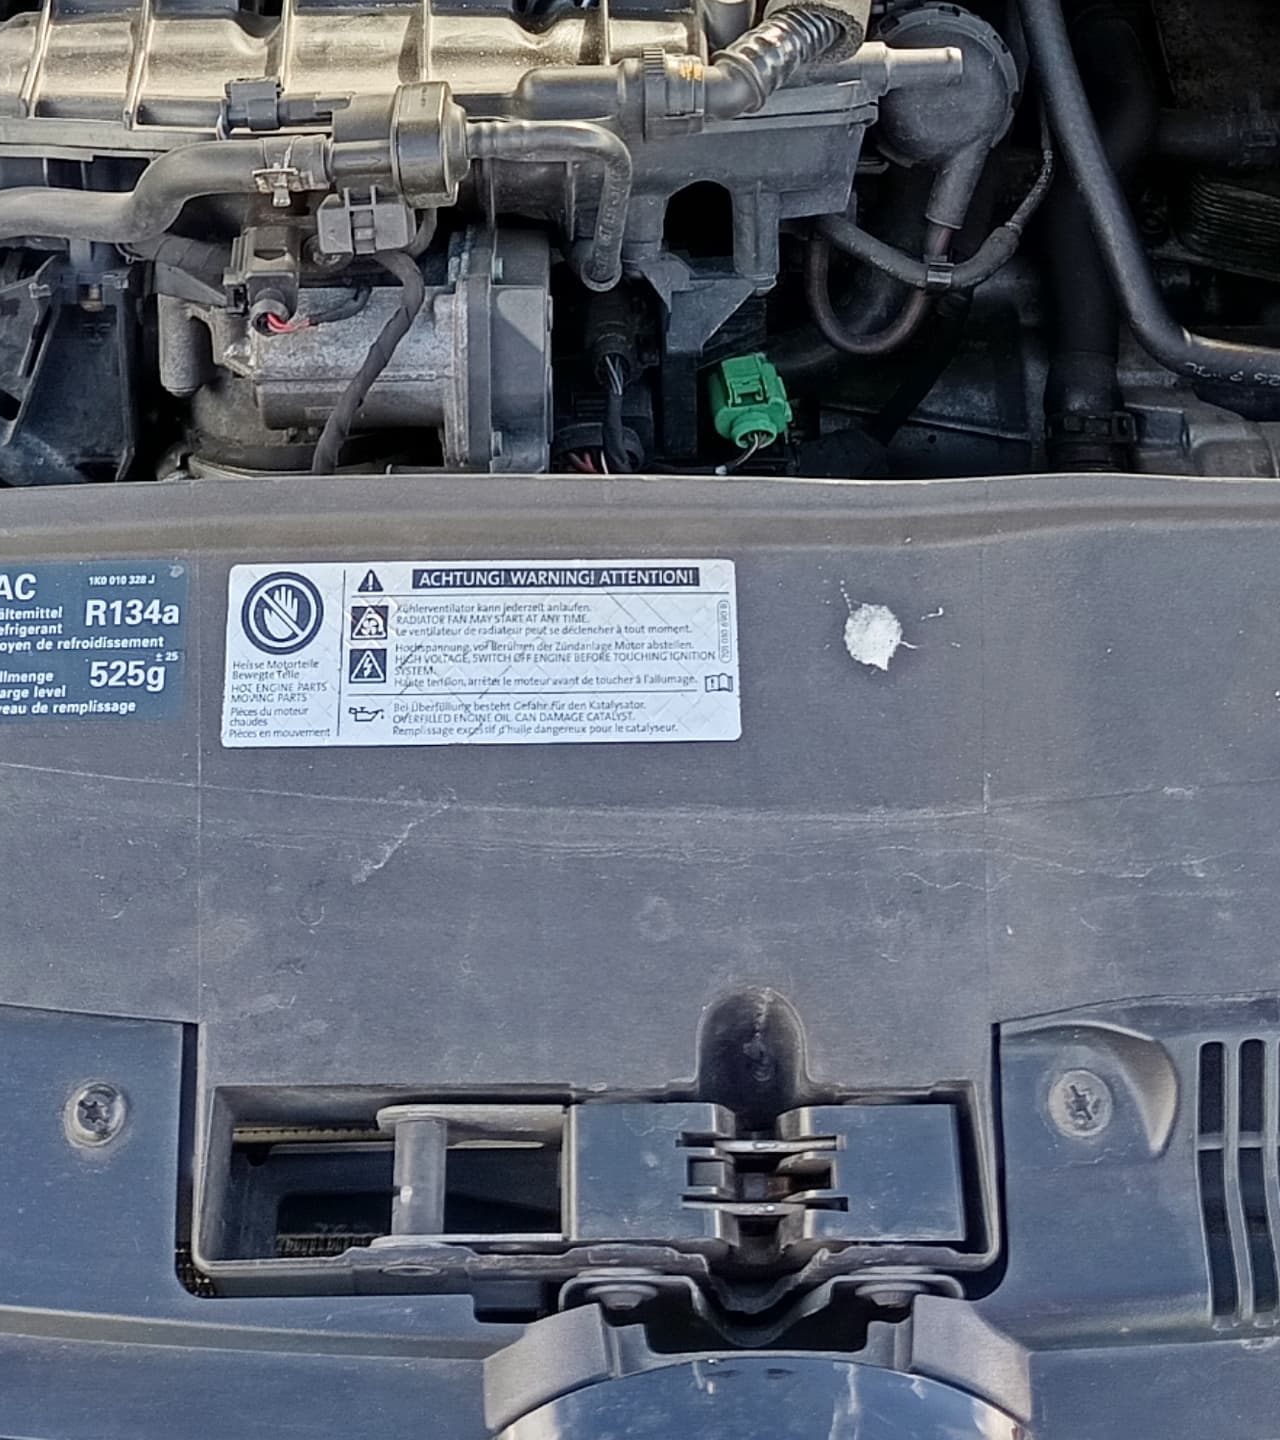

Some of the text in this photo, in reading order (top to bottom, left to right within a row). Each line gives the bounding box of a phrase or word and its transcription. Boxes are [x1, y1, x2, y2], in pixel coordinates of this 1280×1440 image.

[419, 570, 694, 586] ACHTUNG! WARNING! ATTENTION!
[85, 599, 180, 627] R134a
[477, 603, 501, 612] kann
[503, 603, 544, 616] jederzeit
[397, 615, 445, 624] RADIATOR
[447, 615, 468, 624] FAN
[470, 615, 493, 624] MAY
[495, 614, 525, 624] START
[526, 614, 538, 624] AT
[540, 614, 561, 624] ANY
[396, 628, 407, 636] Le
[409, 627, 461, 637] ventilateur
[464, 626, 476, 635] de
[478, 626, 522, 636] radiateur
[525, 626, 548, 637] peut
[562, 625, 614, 635] déclencher
[617, 626, 622, 634] à
[625, 625, 645, 634] tout
[648, 626, 692, 634] moment.
[36, 638, 54, 650] de
[57, 636, 164, 650] refroidissement
[537, 642, 553, 651] der
[555, 641, 612, 652] Zündanlage
[615, 641, 645, 650] Motor
[395, 655, 421, 665] HIGH
[473, 654, 511, 663] SWITCH
[534, 653, 572, 663] ENGINE
[574, 652, 612, 661] BEFORE
[614, 652, 668, 661] TOUCHING
[670, 651, 715, 660] IGNITION
[233, 659, 319, 670] Heisse Motorteile
[90, 660, 166, 692] 525g
[232, 670, 300, 681] Bewegte Teile
[394, 678, 425, 687] Haute
[469, 677, 501, 686] arrêter
[504, 677, 513, 686] le
[515, 678, 550, 686] moteur
[552, 677, 580, 686] avant
[581, 676, 594, 685] de
[596, 675, 634, 684] toucher
[636, 676, 641, 684] à
[33, 685, 66, 698] level
[232, 682, 327, 693] HOT ENGINE PARTS
[231, 693, 307, 703] MOVING PARTS
[31, 701, 48, 714] de
[53, 700, 136, 716] remplissage
[230, 706, 308, 717] Pièces du moteur
[394, 704, 408, 712] Bei
[411, 702, 472, 715] Überfüllung
[474, 702, 510, 711] besteht
[513, 701, 551, 712] Gefahr
[552, 700, 567, 710] für
[569, 701, 586, 710] den
[229, 717, 268, 726] chaudes
[393, 714, 451, 724] OVERFILLED
[454, 713, 492, 723] ENGINE
[494, 714, 510, 722] OIL
[515, 713, 537, 722] CAN
[539, 712, 584, 722] DAMAGE
[229, 728, 257, 738] Pièces
[274, 728, 330, 737] mouvement
[393, 725, 454, 737] Remplissage
[534, 723, 586, 736] dangereux
[589, 724, 612, 734] pour
[615, 723, 624, 732] le
